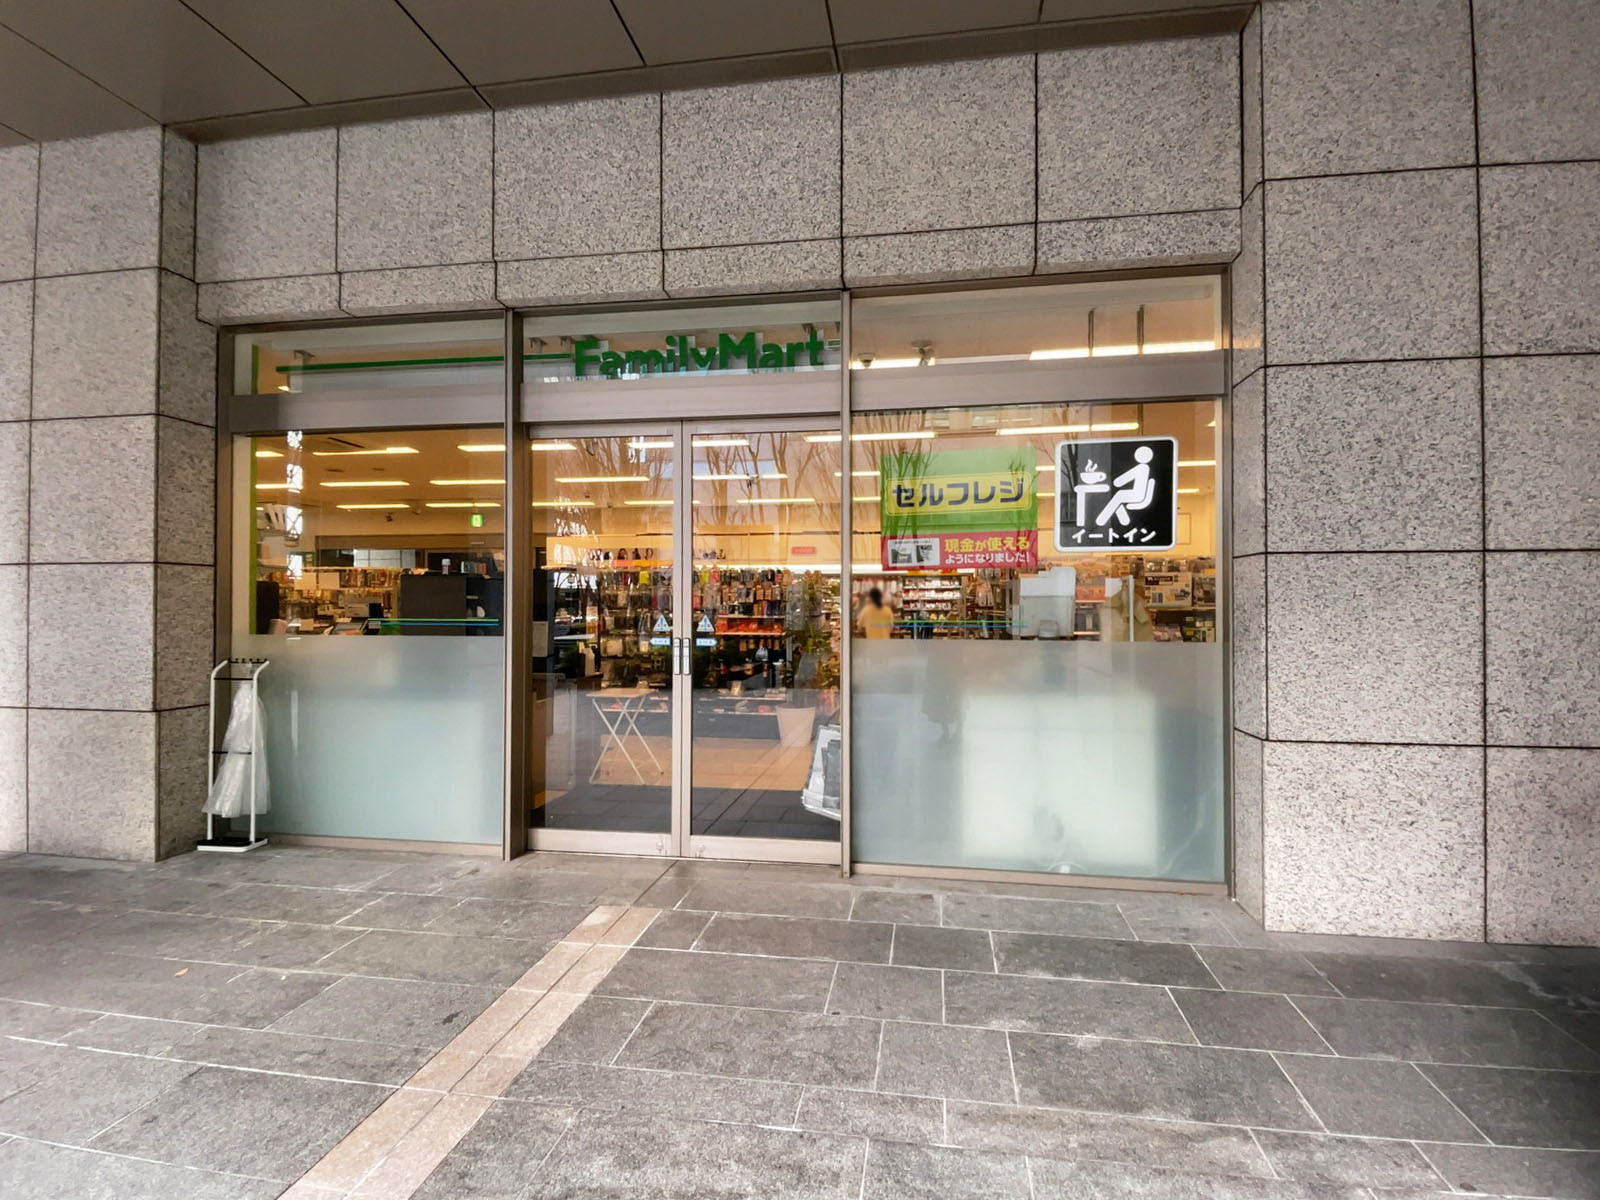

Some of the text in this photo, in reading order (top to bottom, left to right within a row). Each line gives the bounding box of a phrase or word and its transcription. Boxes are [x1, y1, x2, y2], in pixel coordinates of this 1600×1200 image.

[893, 477, 1024, 507] セルフレジ
[1072, 527, 1156, 543] イートイン
[944, 536, 1030, 552] 現金が使える
